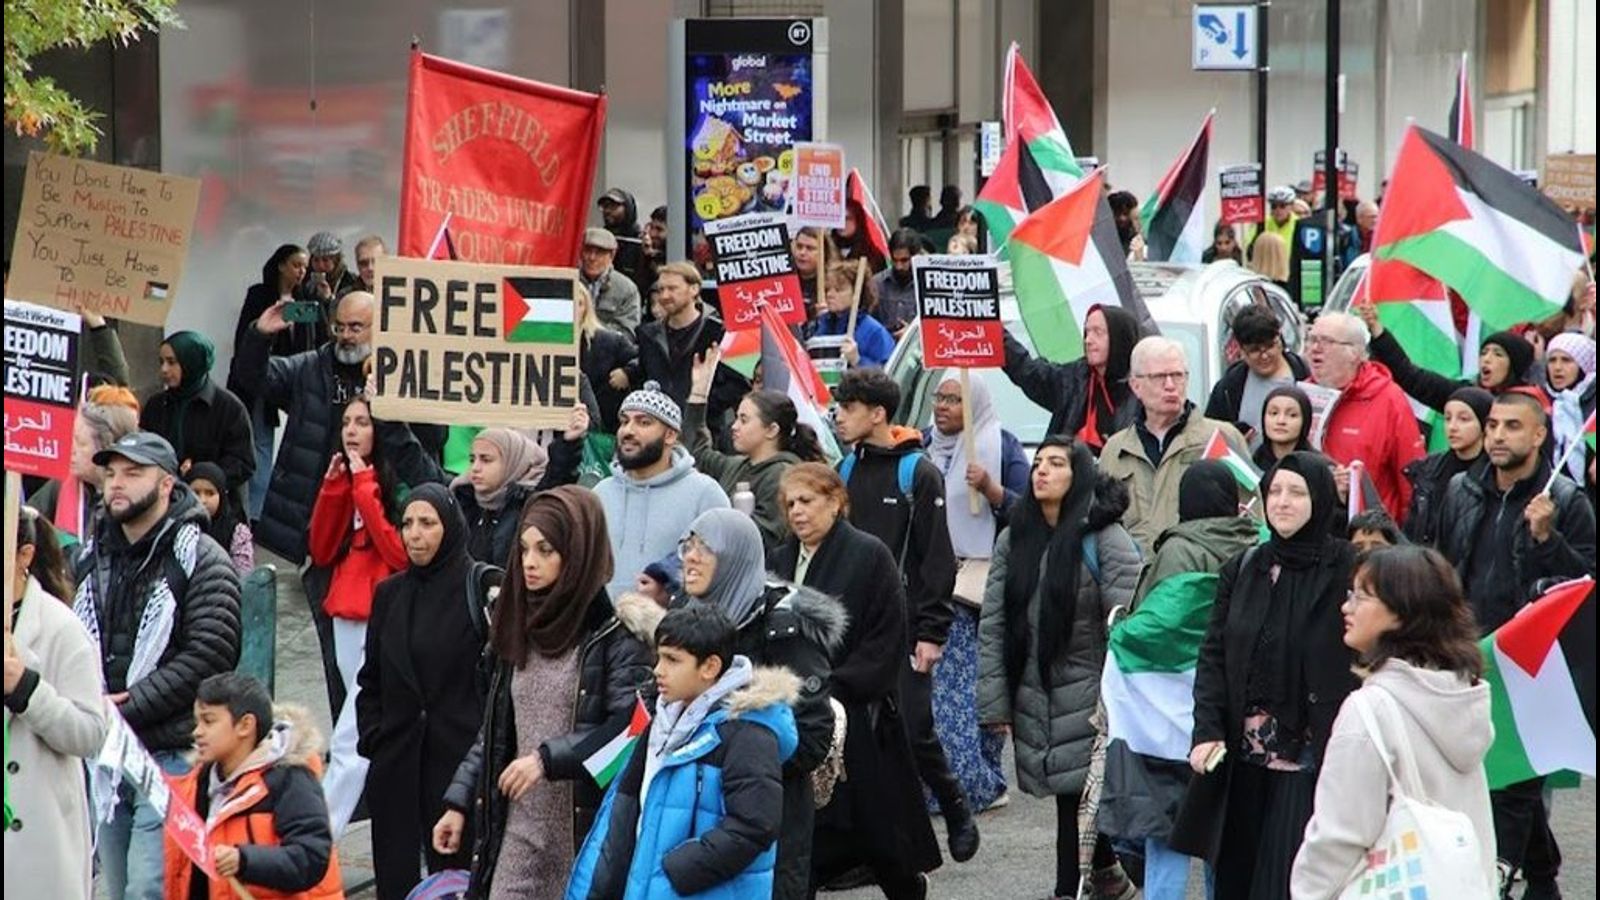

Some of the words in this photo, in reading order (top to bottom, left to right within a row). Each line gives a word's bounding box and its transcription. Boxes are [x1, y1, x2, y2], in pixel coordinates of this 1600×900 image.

[732, 56, 766, 71] global
[708, 81, 751, 98] More
[700, 98, 771, 117] Nightmare
[773, 101, 787, 110] on
[742, 112, 797, 129] Market
[432, 101, 560, 188] SHEFFIELD
[744, 128, 794, 145] Street.
[31, 154, 61, 183] You
[120, 171, 148, 197] Have
[155, 179, 173, 201] To
[808, 163, 832, 177] END
[41, 183, 61, 203] Be
[73, 189, 127, 215] Muslim
[132, 200, 149, 217] To
[417, 175, 499, 223] TRADES
[804, 189, 836, 203] STATE
[34, 203, 91, 231] Support
[104, 213, 183, 246] PALESTINE
[456, 230, 535, 262] OUNCIL
[714, 227, 783, 255] FREEDOM
[1306, 228, 1320, 249] P
[27, 231, 59, 261] You
[70, 237, 107, 268] Just
[124, 250, 160, 277] Have
[717, 254, 793, 281] PALESTINE
[104, 268, 128, 289] Be
[925, 270, 991, 291] FREEDOM
[55, 285, 131, 313] HUMAN
[380, 275, 497, 338] FREE
[924, 297, 997, 317] PALESTINE
[4, 325, 69, 362] EEDOM
[938, 323, 986, 342] الحرية
[934, 342, 994, 358] لفلسطين
[4, 366, 72, 403] ESTINE
[376, 346, 577, 408] PALESTINE
